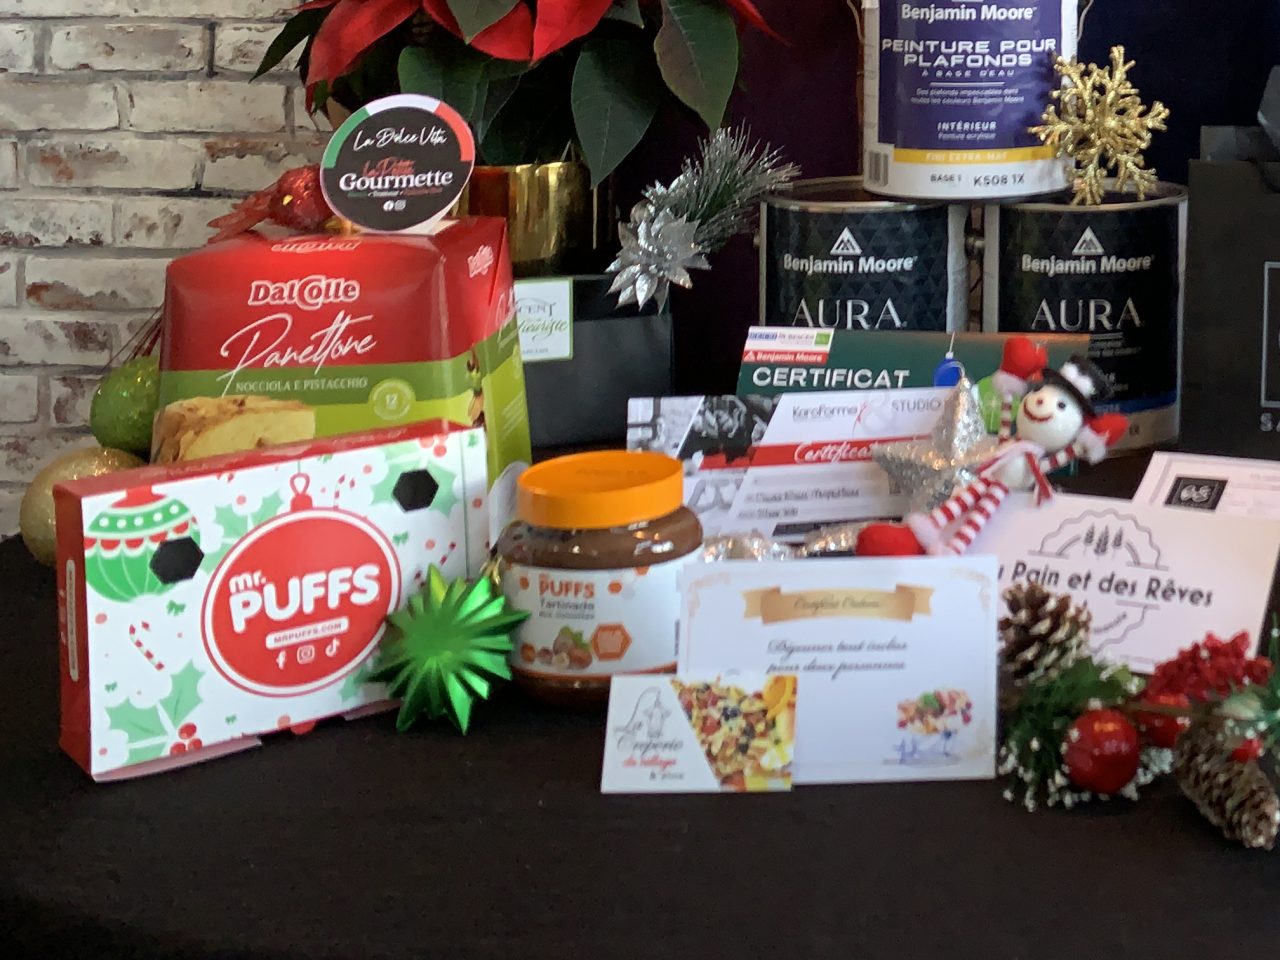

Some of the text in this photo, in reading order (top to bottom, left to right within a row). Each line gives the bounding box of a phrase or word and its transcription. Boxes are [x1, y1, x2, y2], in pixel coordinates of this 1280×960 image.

[902, 3, 1035, 23] Benjamin Moore
[882, 38, 1056, 53] PEINTURE POUR
[904, 53, 1032, 68] PLAFONDS
[938, 121, 997, 132] INTÉRIEUR
[353, 125, 447, 152] La Dolce Vita
[339, 170, 453, 192] Gourmette
[930, 174, 955, 182] BASE
[784, 253, 914, 275] Benjamin Moore
[1022, 253, 1152, 277] Benjamin Moore
[792, 297, 906, 330] AURA
[1031, 297, 1144, 331] AURA
[216, 310, 377, 398] Panettone
[757, 351, 823, 362] Benjamin Moore
[235, 381, 291, 393] NOCCIOLA
[303, 377, 367, 391] PISTACCHIO
[753, 366, 911, 388] CERTIFICAT
[892, 397, 942, 412] STUDIO
[229, 570, 266, 593] mr.
[538, 579, 595, 599] PUFFS
[1011, 560, 1213, 607] Pain et des Rêves
[229, 564, 380, 634] PUFFS
[274, 622, 342, 644] MRPUFFS.COM
